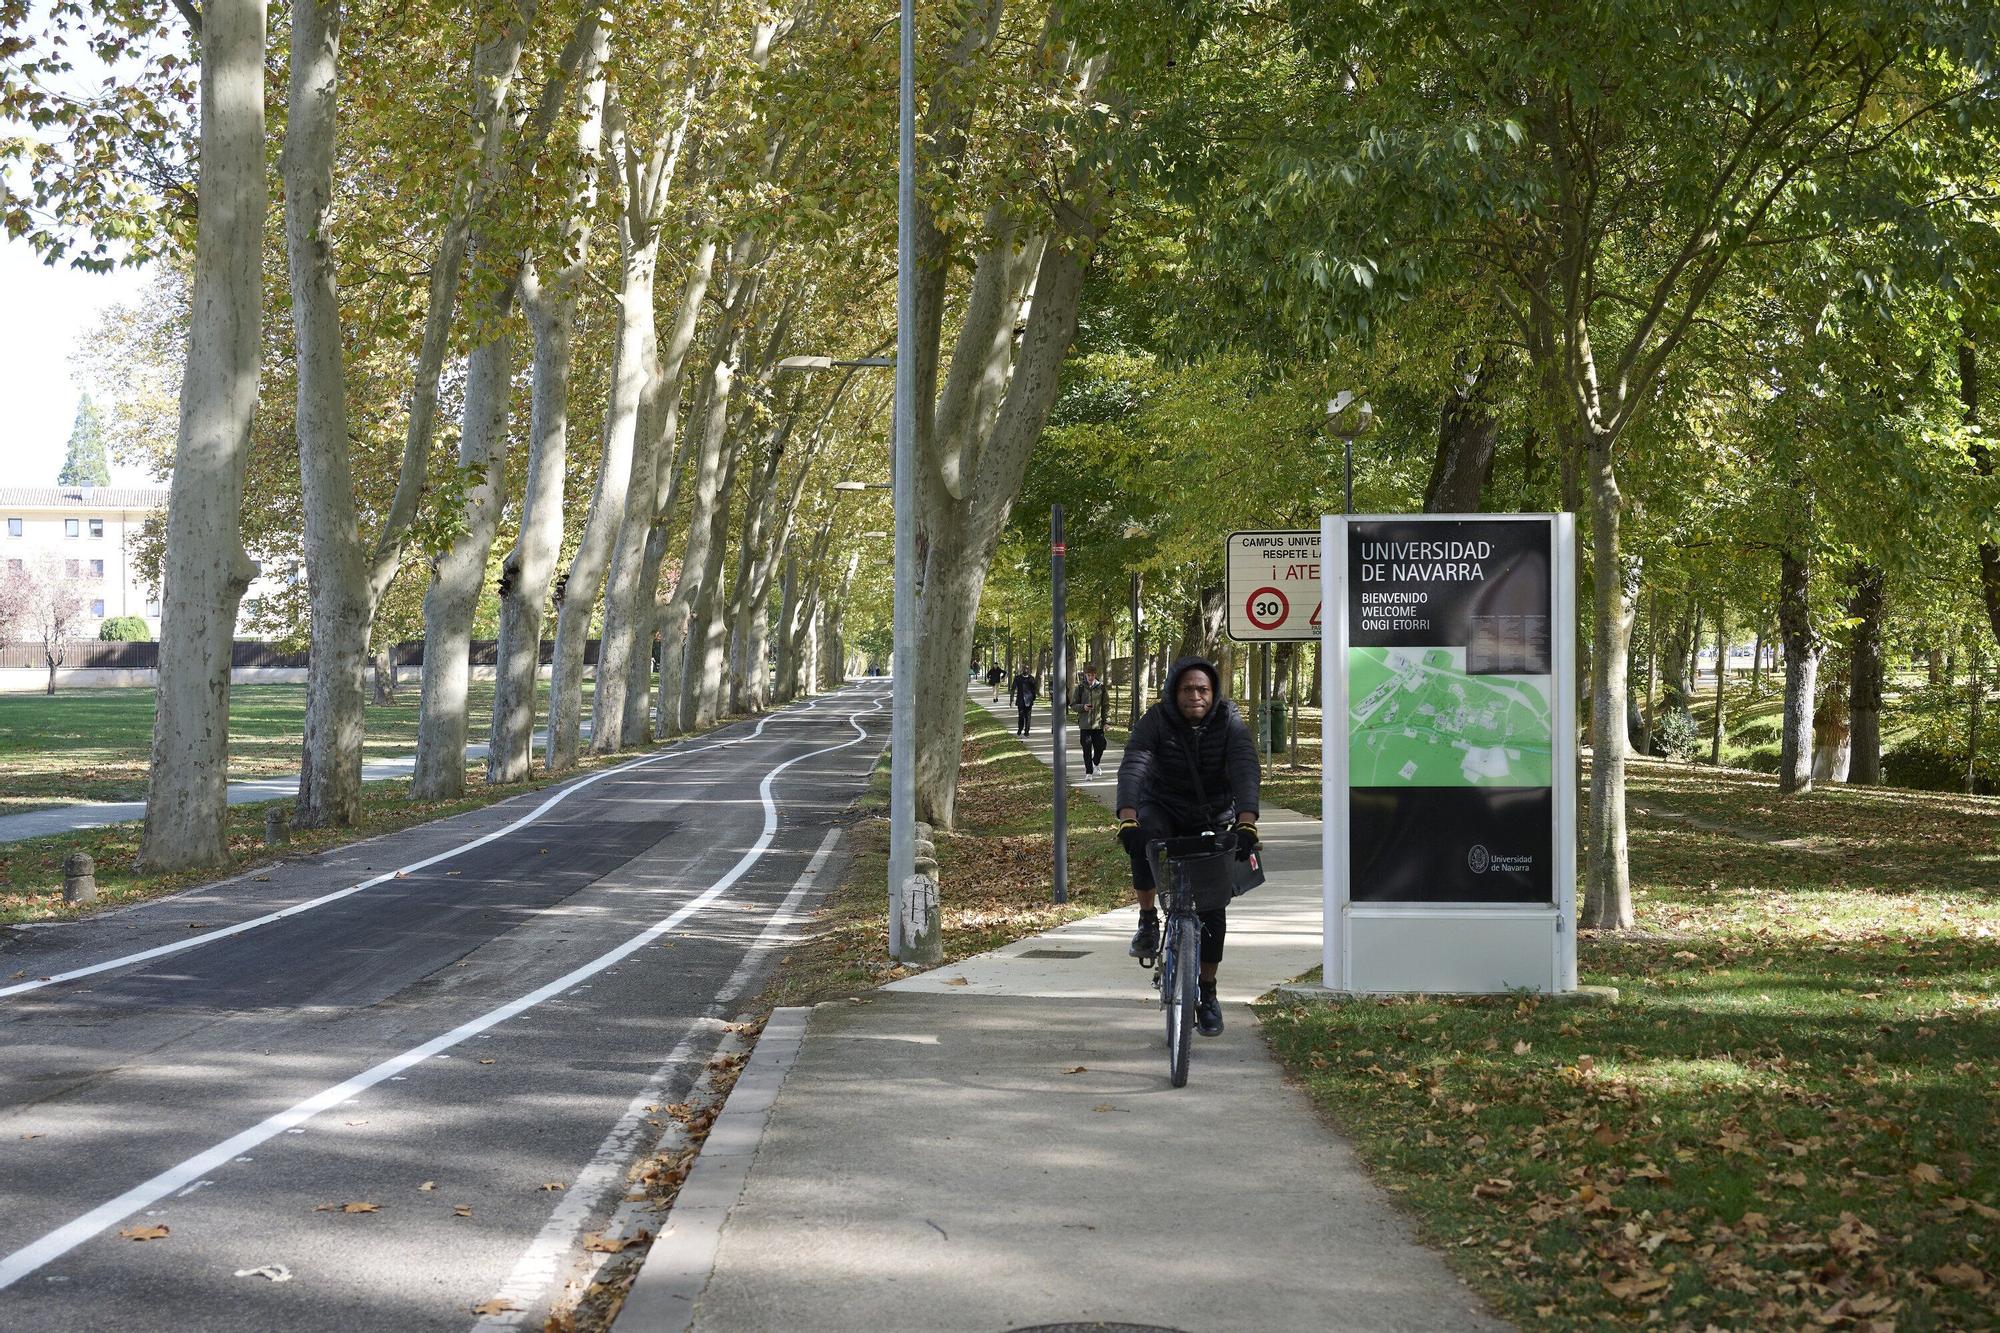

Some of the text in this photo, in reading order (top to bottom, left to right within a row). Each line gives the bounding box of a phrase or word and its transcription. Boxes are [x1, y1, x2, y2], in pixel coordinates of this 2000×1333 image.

[1242, 538, 1283, 547] CAMPUS
[1263, 549, 1321, 558] RESPETE L
[1361, 541, 1490, 560] UNIVERSIDAD
[1285, 564, 1321, 580] ATE
[1362, 563, 1484, 582] DE NAVARRA
[1362, 592, 1428, 604] BIENVENIDO
[1256, 602, 1279, 616] 30
[1361, 606, 1417, 617] WELCOME
[1361, 619, 1430, 631] ONGI ETORRI
[1491, 855, 1533, 863] Universidad
[1491, 863, 1530, 872] de Navarra
